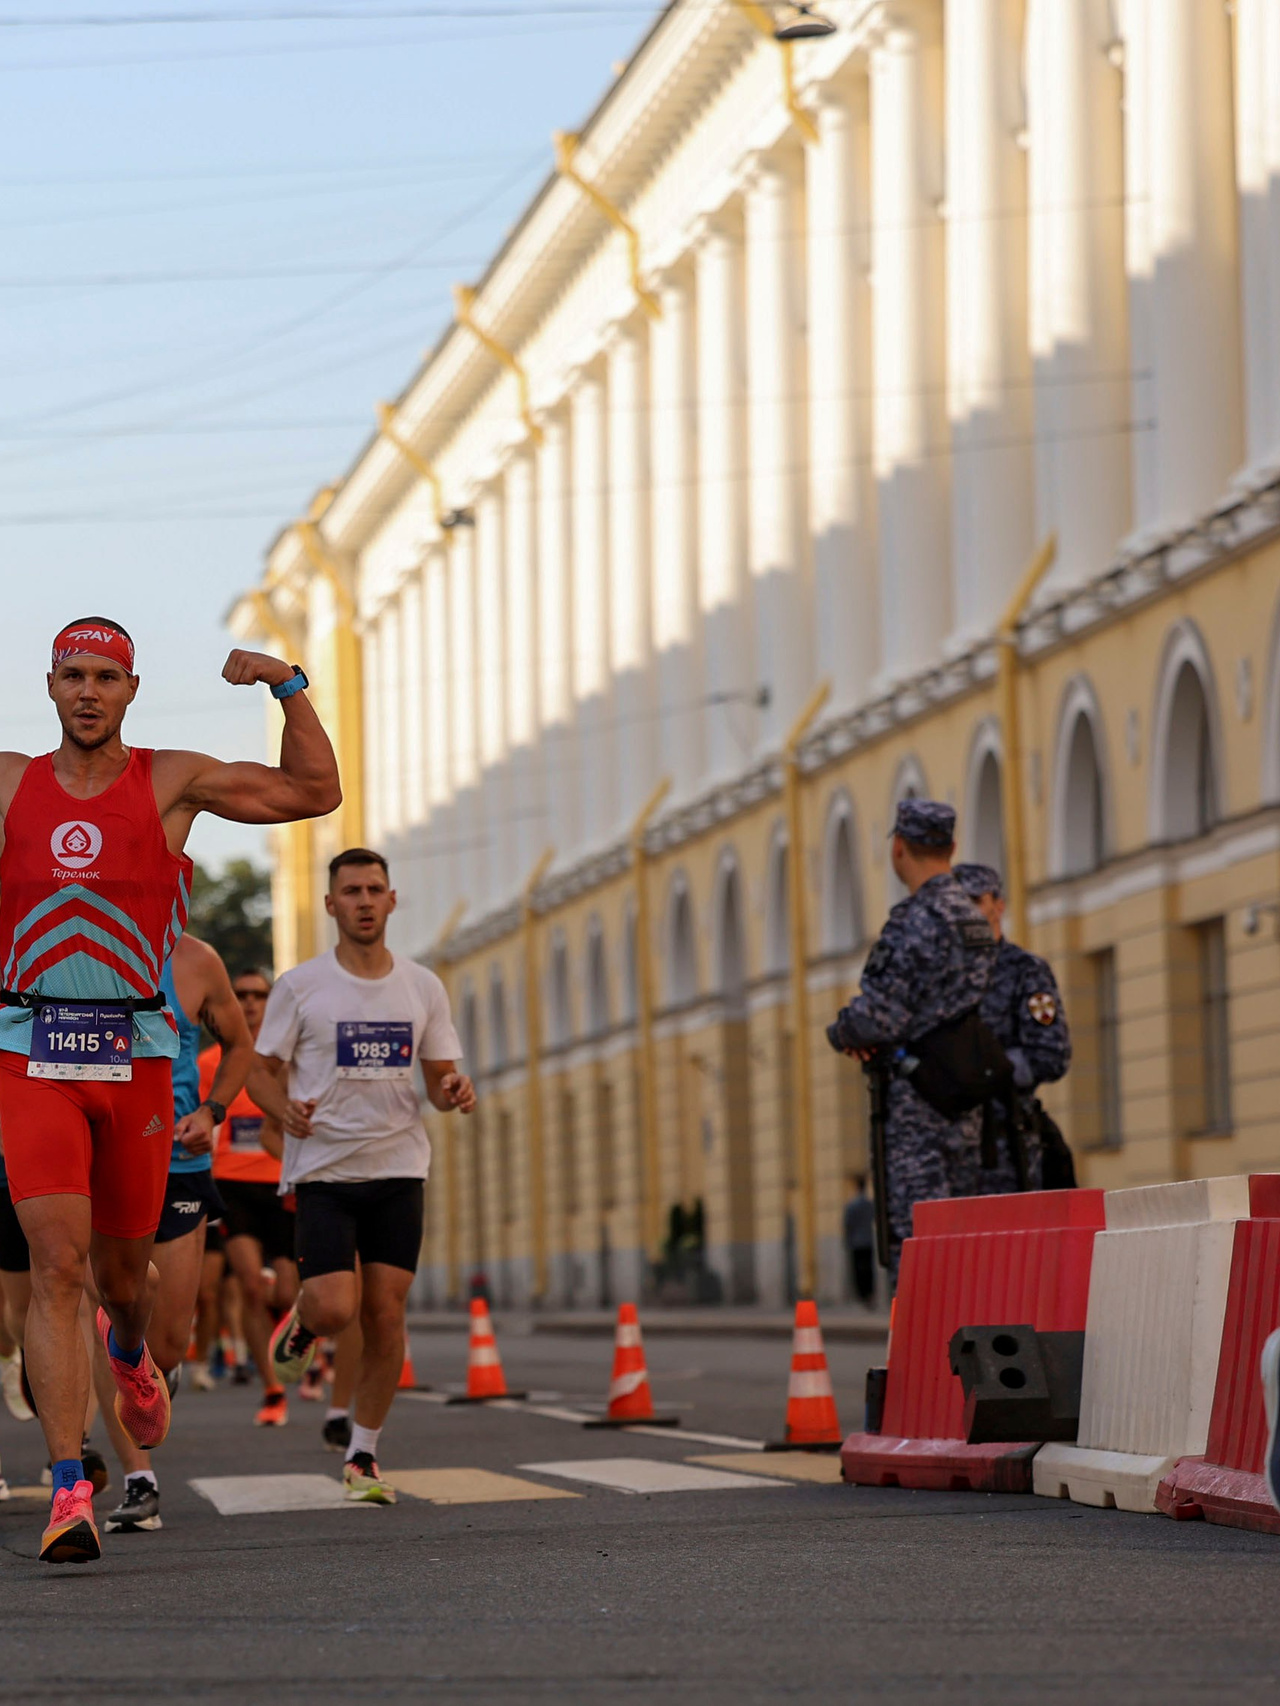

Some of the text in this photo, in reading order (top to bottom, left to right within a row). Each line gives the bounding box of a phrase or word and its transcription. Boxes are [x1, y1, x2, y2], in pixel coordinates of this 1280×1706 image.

[66, 629, 113, 643] RAY
[51, 868, 100, 880] Теремок
[48, 1032, 100, 1052] 11415
[351, 1043, 391, 1058] 1983
[142, 1124, 165, 1137] adidas
[171, 1201, 202, 1214] RAY
